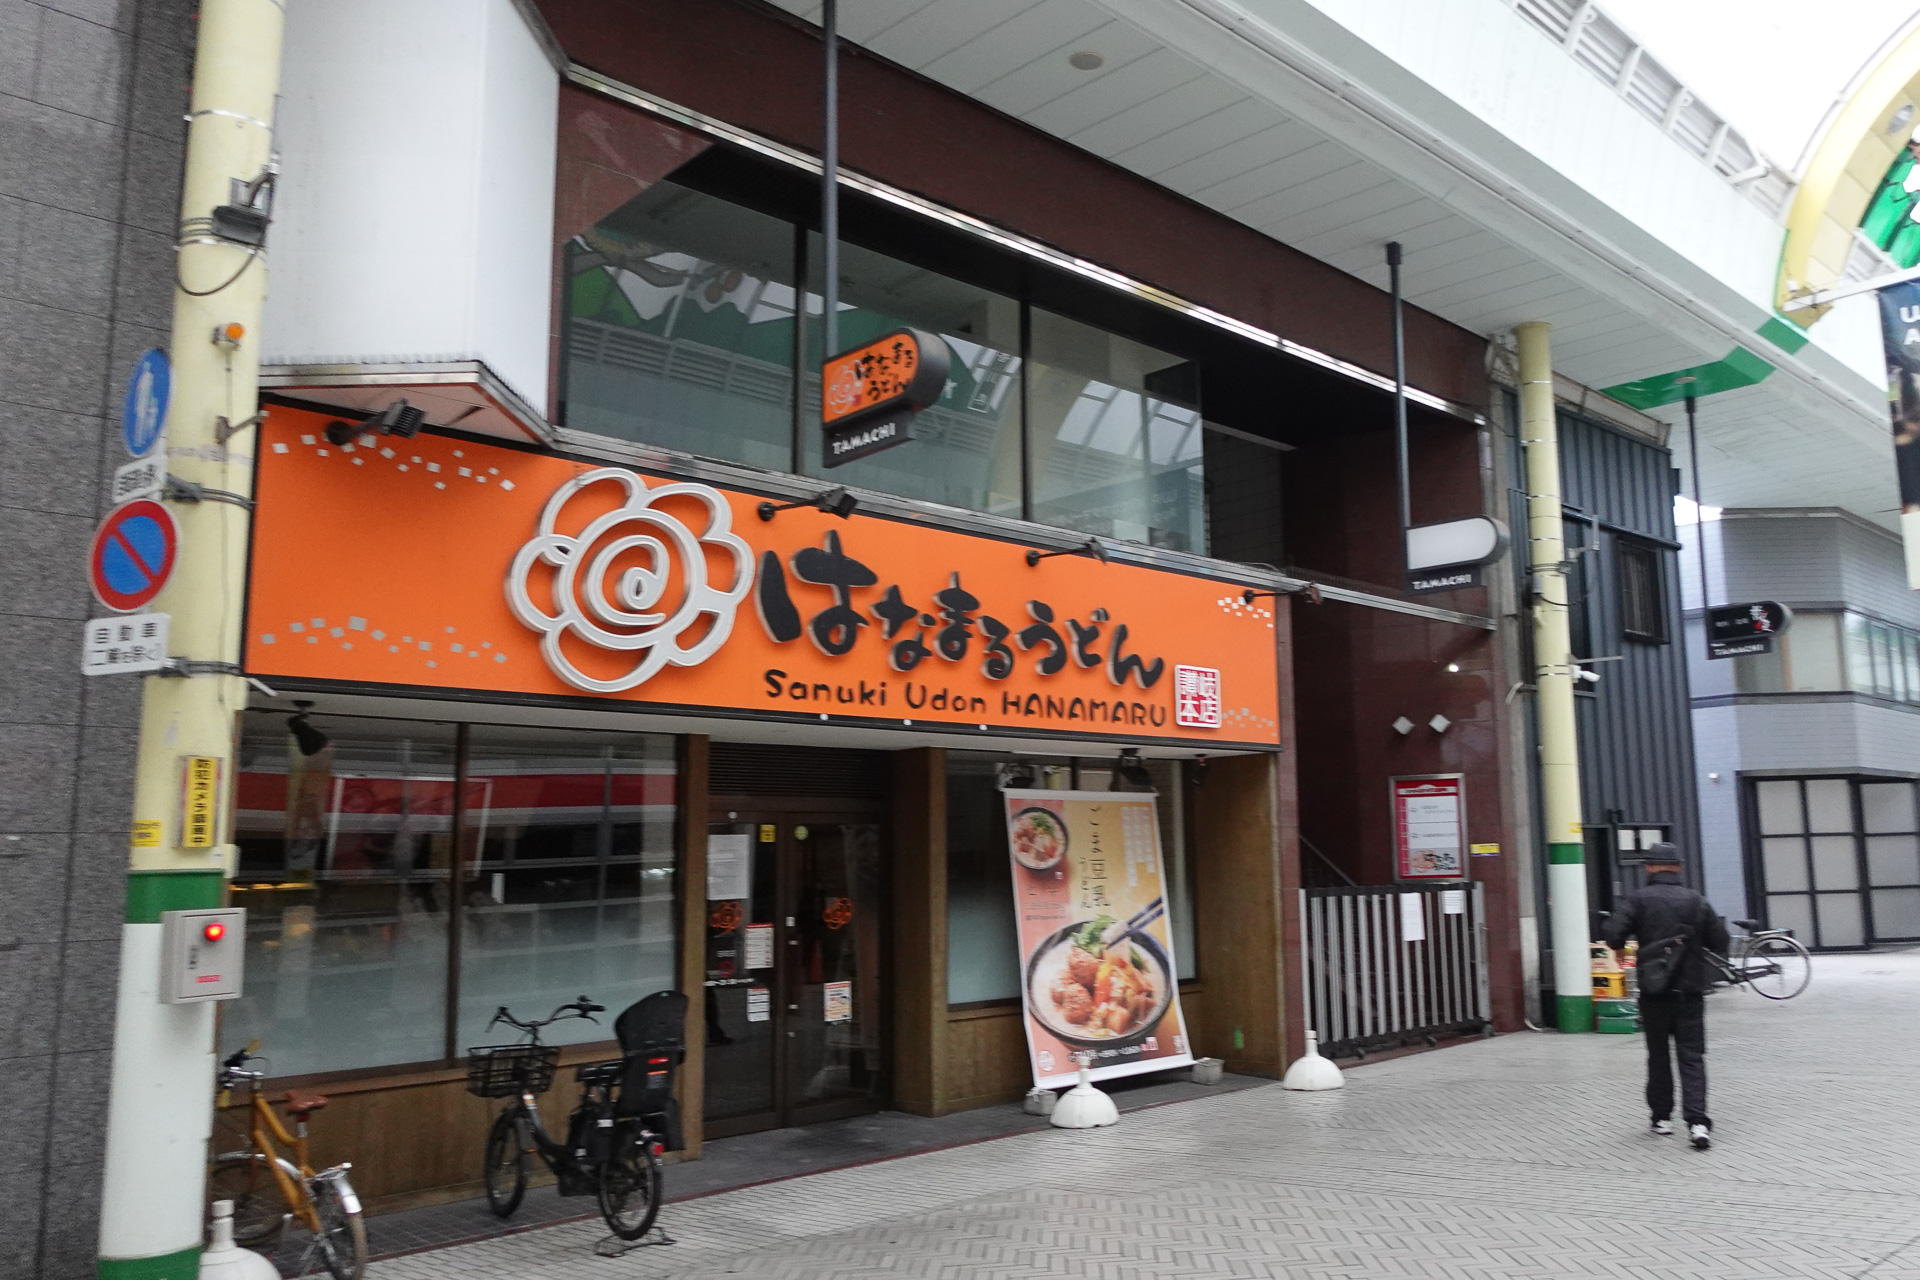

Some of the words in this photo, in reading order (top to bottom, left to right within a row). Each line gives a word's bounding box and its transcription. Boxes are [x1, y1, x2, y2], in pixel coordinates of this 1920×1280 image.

[855, 342, 914, 380] はなまる
[833, 423, 896, 454] TAMACHI
[1413, 575, 1472, 590] TAMACHI
[755, 529, 1165, 689] はなまるうどん
[94, 622, 159, 645] 自動車
[763, 668, 887, 707] Sanuki
[905, 684, 987, 714] Udon
[1002, 692, 1167, 728] HANAMARU
[1179, 699, 1219, 723] 本店
